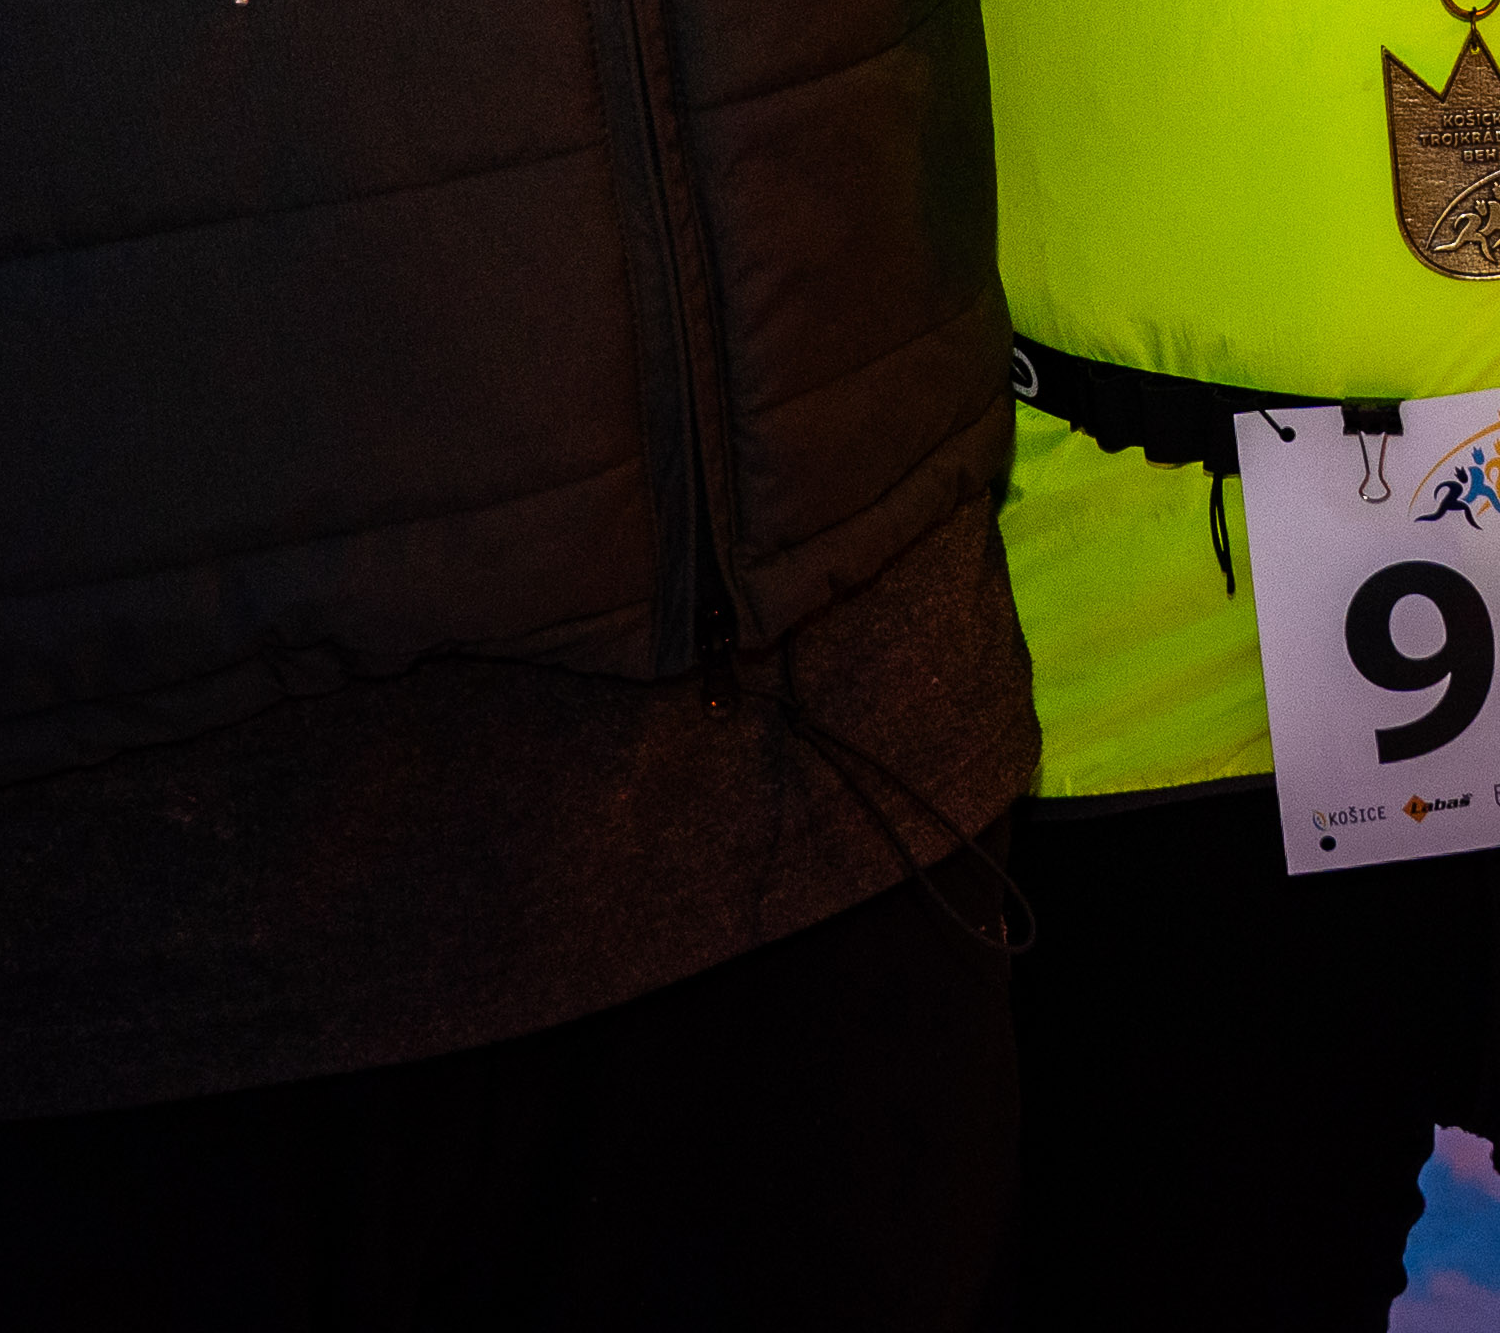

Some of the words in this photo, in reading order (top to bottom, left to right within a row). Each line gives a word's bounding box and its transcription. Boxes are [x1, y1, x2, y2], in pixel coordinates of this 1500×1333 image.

[1463, 149, 1498, 162] BEH
[1410, 793, 1473, 815] Labaš
[1329, 806, 1387, 827] KOŠICE
